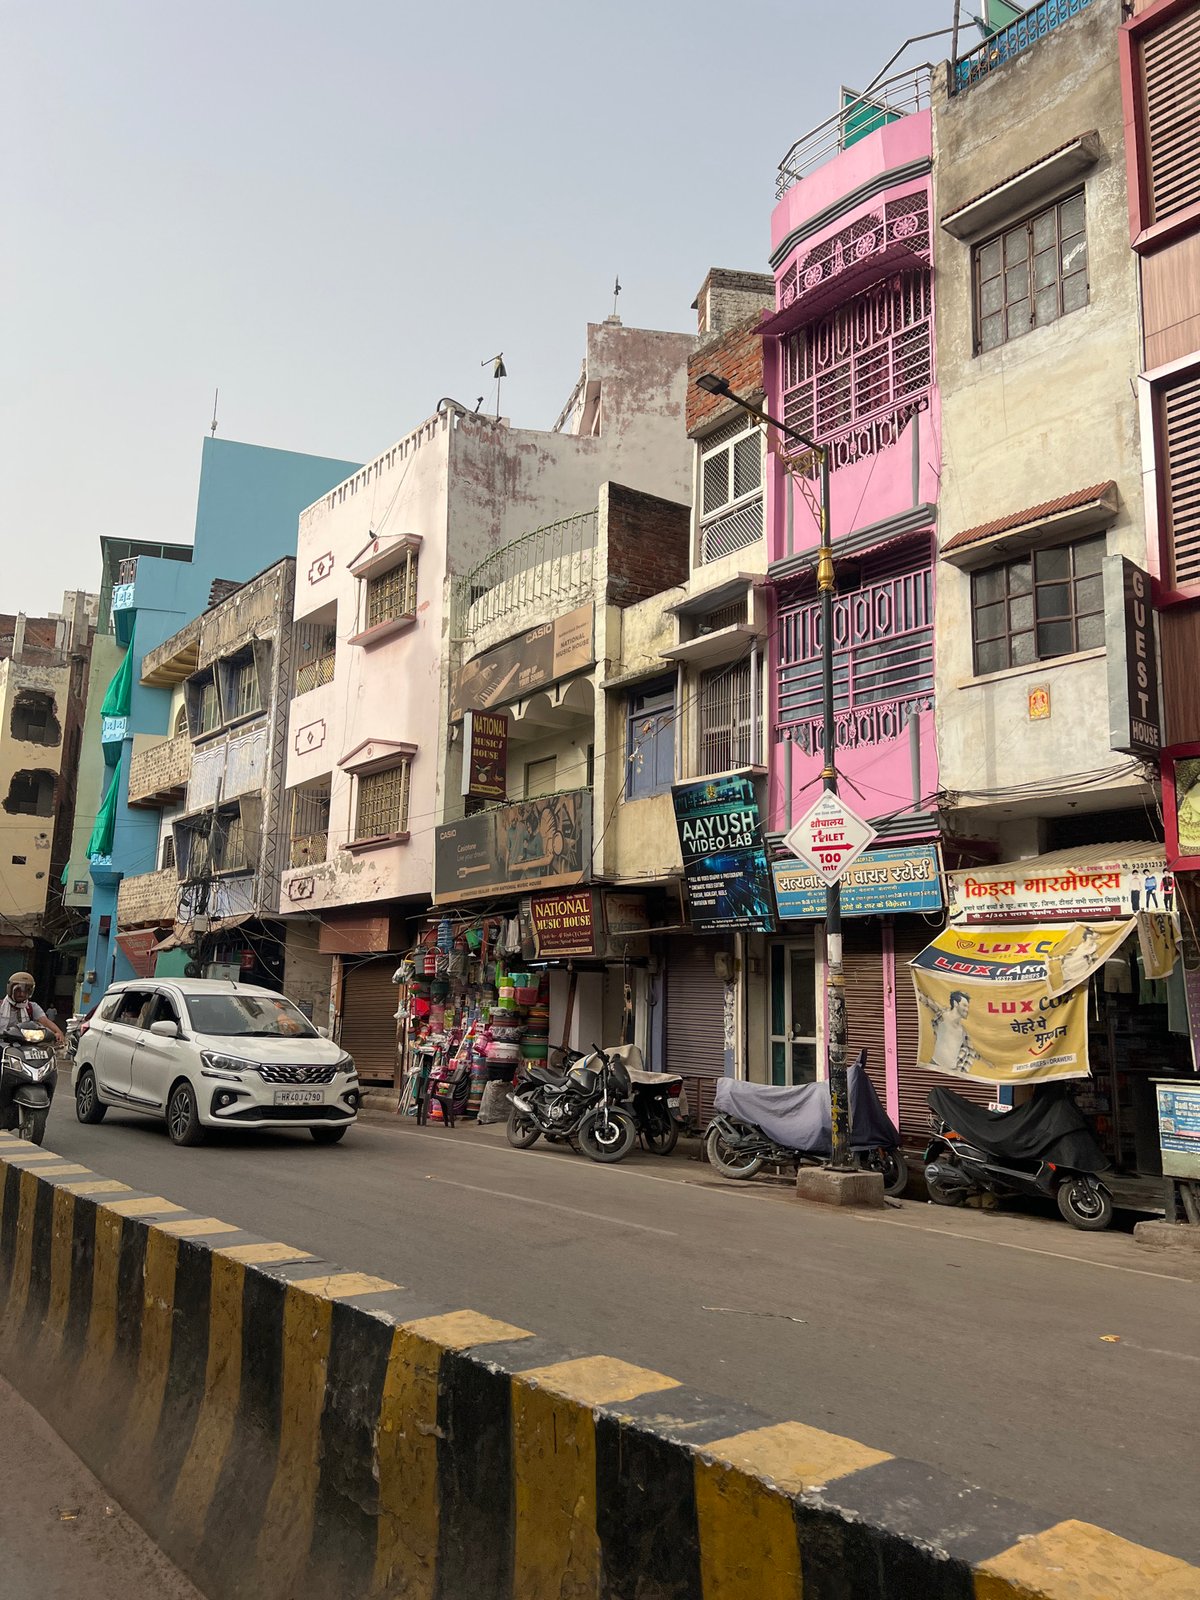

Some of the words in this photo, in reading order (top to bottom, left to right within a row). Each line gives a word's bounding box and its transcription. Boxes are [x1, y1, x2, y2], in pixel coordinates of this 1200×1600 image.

[525, 623, 553, 644] CASIO
[560, 633, 584, 648] NATIONAL
[556, 646, 571, 658] MUSIC
[571, 638, 589, 651] HOUSE
[1132, 571, 1149, 718] GUEST
[473, 714, 506, 738] NATIONAL
[1132, 720, 1159, 747] HOUSE
[474, 736, 498, 749] MUSIC
[472, 747, 499, 760] HOUSE
[440, 829, 457, 841] CASIO
[683, 810, 756, 842] AAYUSH
[688, 835, 726, 854] VIDEO
[728, 832, 753, 849] LAB
[819, 852, 842, 864] 100
[854, 867, 888, 884] वायर
[890, 857, 930, 881] स्टोर्स
[964, 877, 1017, 902] किड्स
[1023, 869, 1122, 896] गारमेण्ट्स
[535, 898, 590, 918] NATIONAL
[537, 918, 562, 930] MUSIC
[562, 915, 591, 928] HOUSE
[977, 942, 1031, 954] LUX
[934, 956, 994, 976] LUX
[987, 1000, 1034, 1014] LUX
[1010, 1018, 1036, 1035] चेहरे
[1036, 1015, 1047, 1030] पे
[1049, 1055, 1073, 1065] DRAWERS
